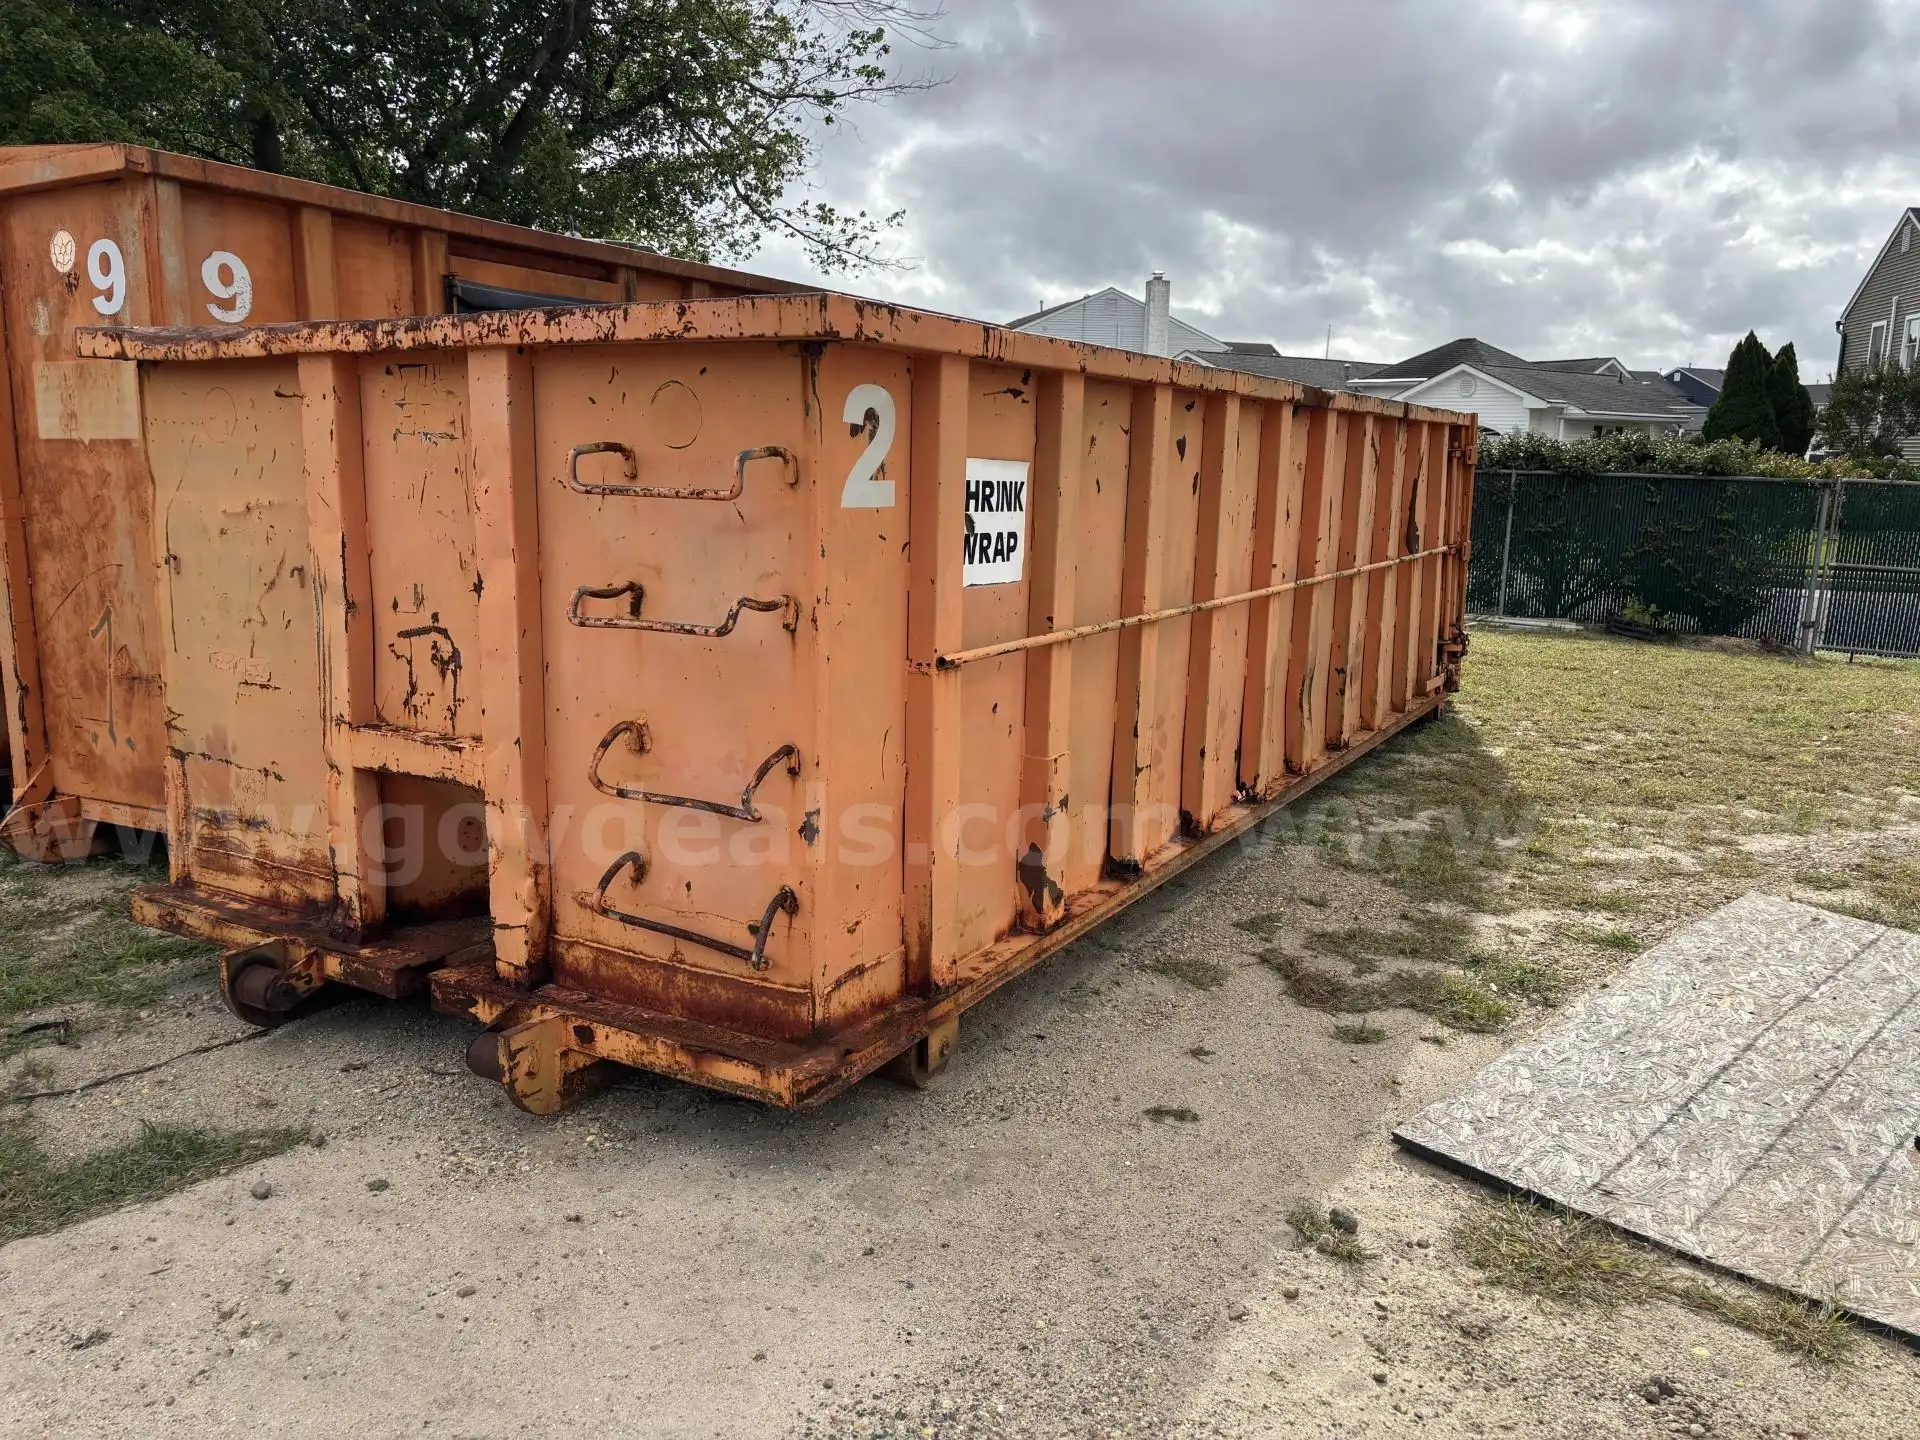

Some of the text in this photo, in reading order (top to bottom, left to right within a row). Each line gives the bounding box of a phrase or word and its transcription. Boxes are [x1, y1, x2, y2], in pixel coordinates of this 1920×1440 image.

[87, 238, 126, 315] 9
[201, 250, 253, 323] 9
[840, 383, 896, 508] 2
